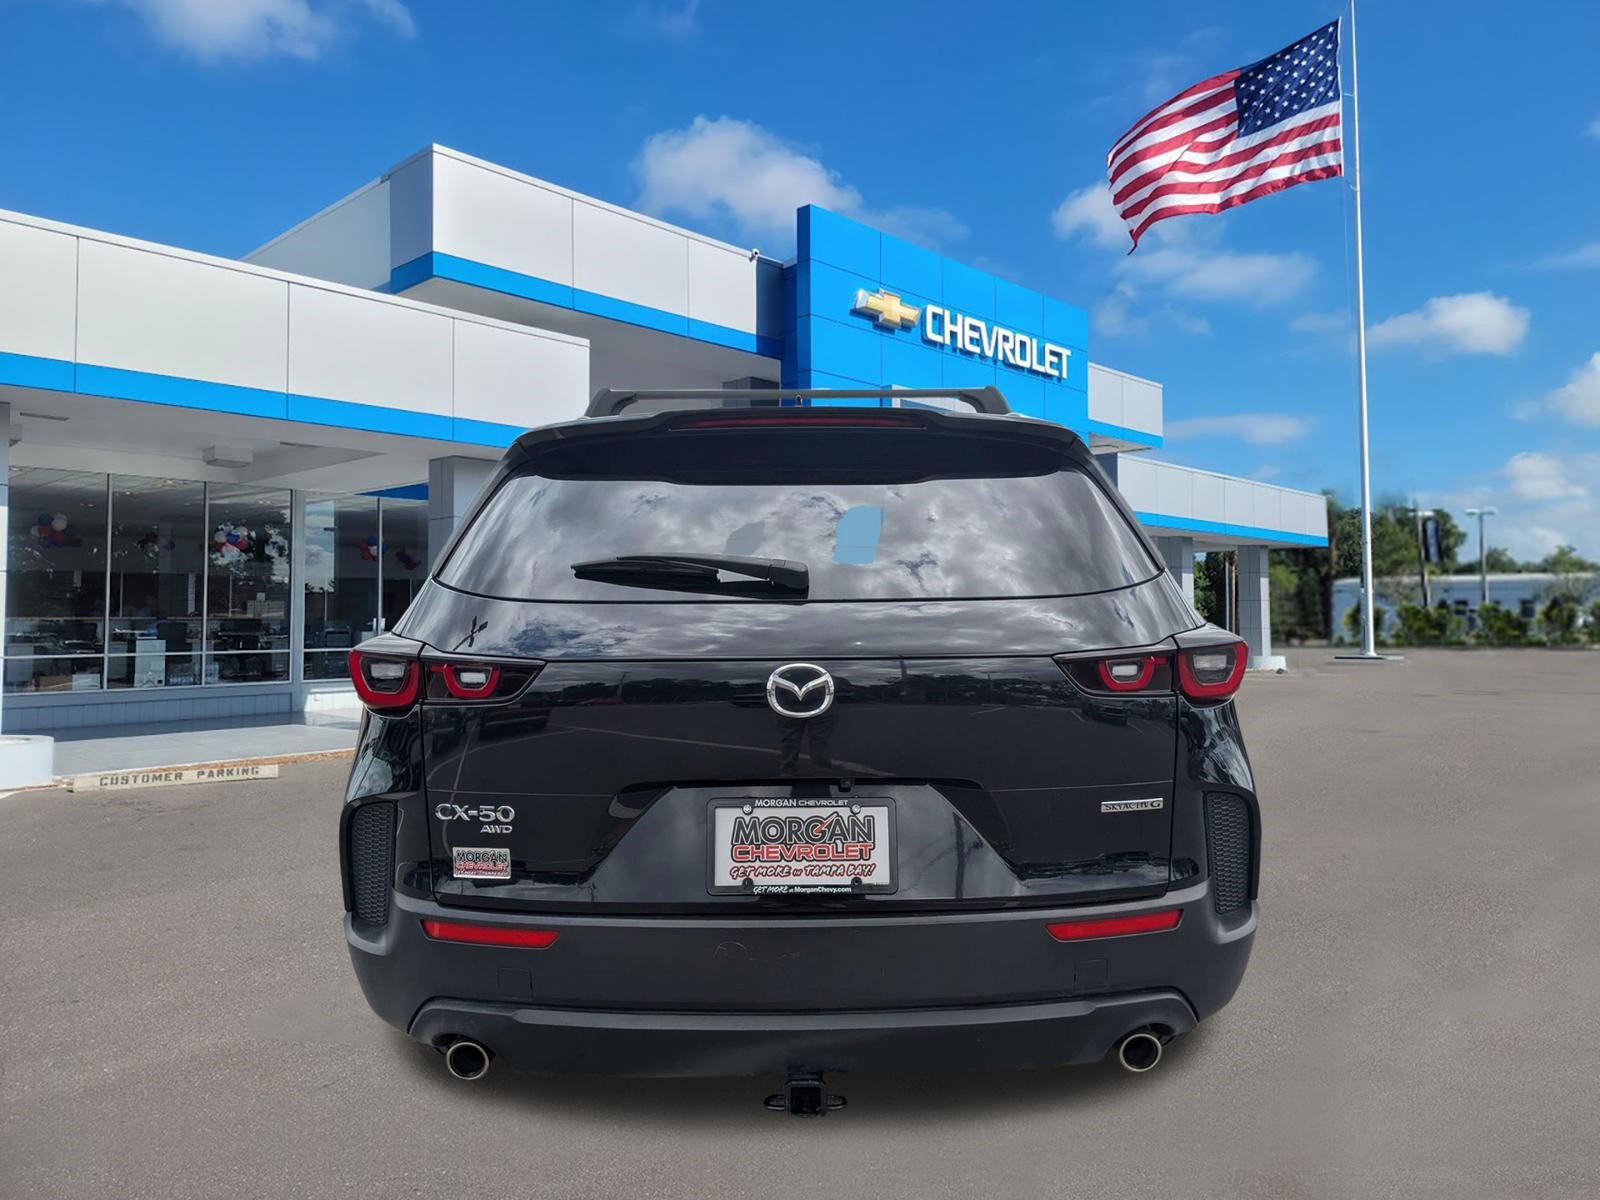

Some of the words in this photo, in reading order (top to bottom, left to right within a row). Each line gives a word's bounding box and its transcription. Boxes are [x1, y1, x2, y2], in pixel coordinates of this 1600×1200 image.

[924, 304, 1071, 379] CHEVROLET
[99, 772, 183, 786] CUSTOMER
[197, 766, 259, 779] PARKING
[754, 799, 797, 807] MORGAN
[435, 803, 515, 822] CX-50
[480, 825, 513, 834] AWD
[732, 813, 875, 844] MORGAN
[456, 850, 508, 862] MORGAN
[731, 843, 875, 862] CHEVROLET
[730, 866, 754, 879] GET
[754, 865, 791, 877] MORE
[804, 864, 845, 877] TAMPA
[846, 864, 876, 877] BAY!
[794, 886, 852, 894] MorganChevy.com
